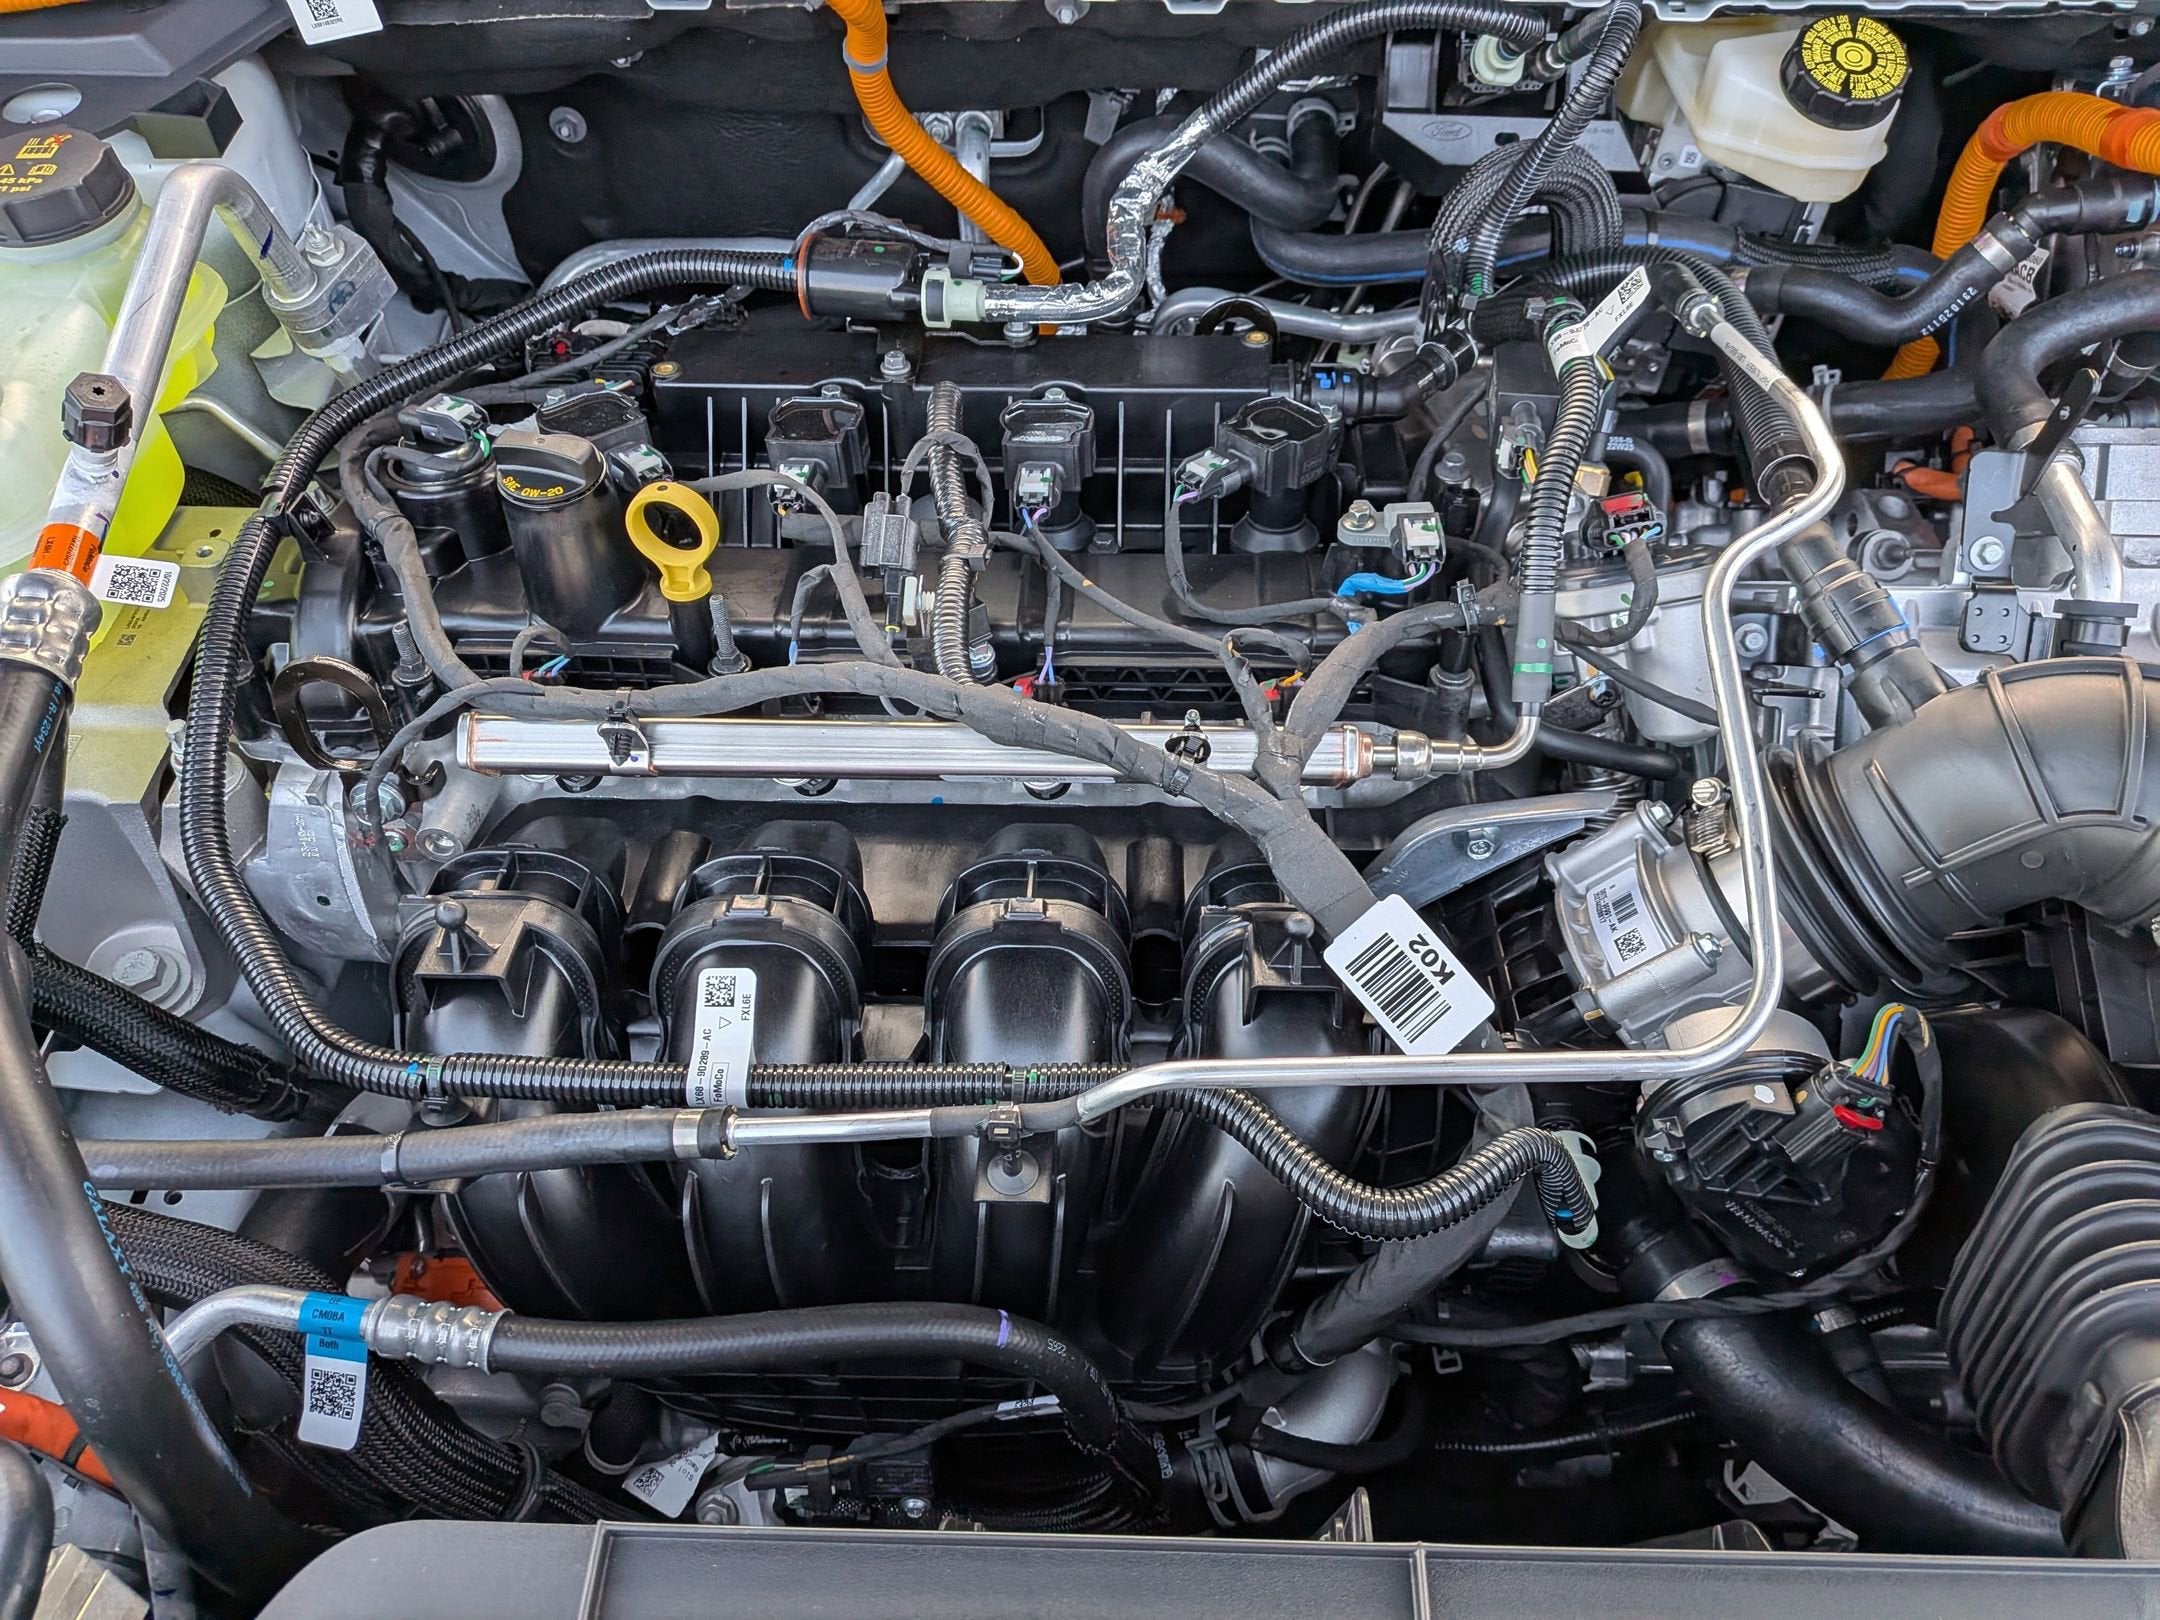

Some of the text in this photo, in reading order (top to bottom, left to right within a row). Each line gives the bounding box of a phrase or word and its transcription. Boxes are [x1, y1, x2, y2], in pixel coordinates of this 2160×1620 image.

[503, 476, 564, 497] SAE 0W-20
[82, 543, 97, 573] FoMoCo
[34, 702, 57, 753] R-1234yf
[741, 993, 751, 1021] FXL6E
[713, 1068, 724, 1103] FoMoCo
[83, 1181, 135, 1279] GALAXY
[319, 1338, 339, 1350] Both
